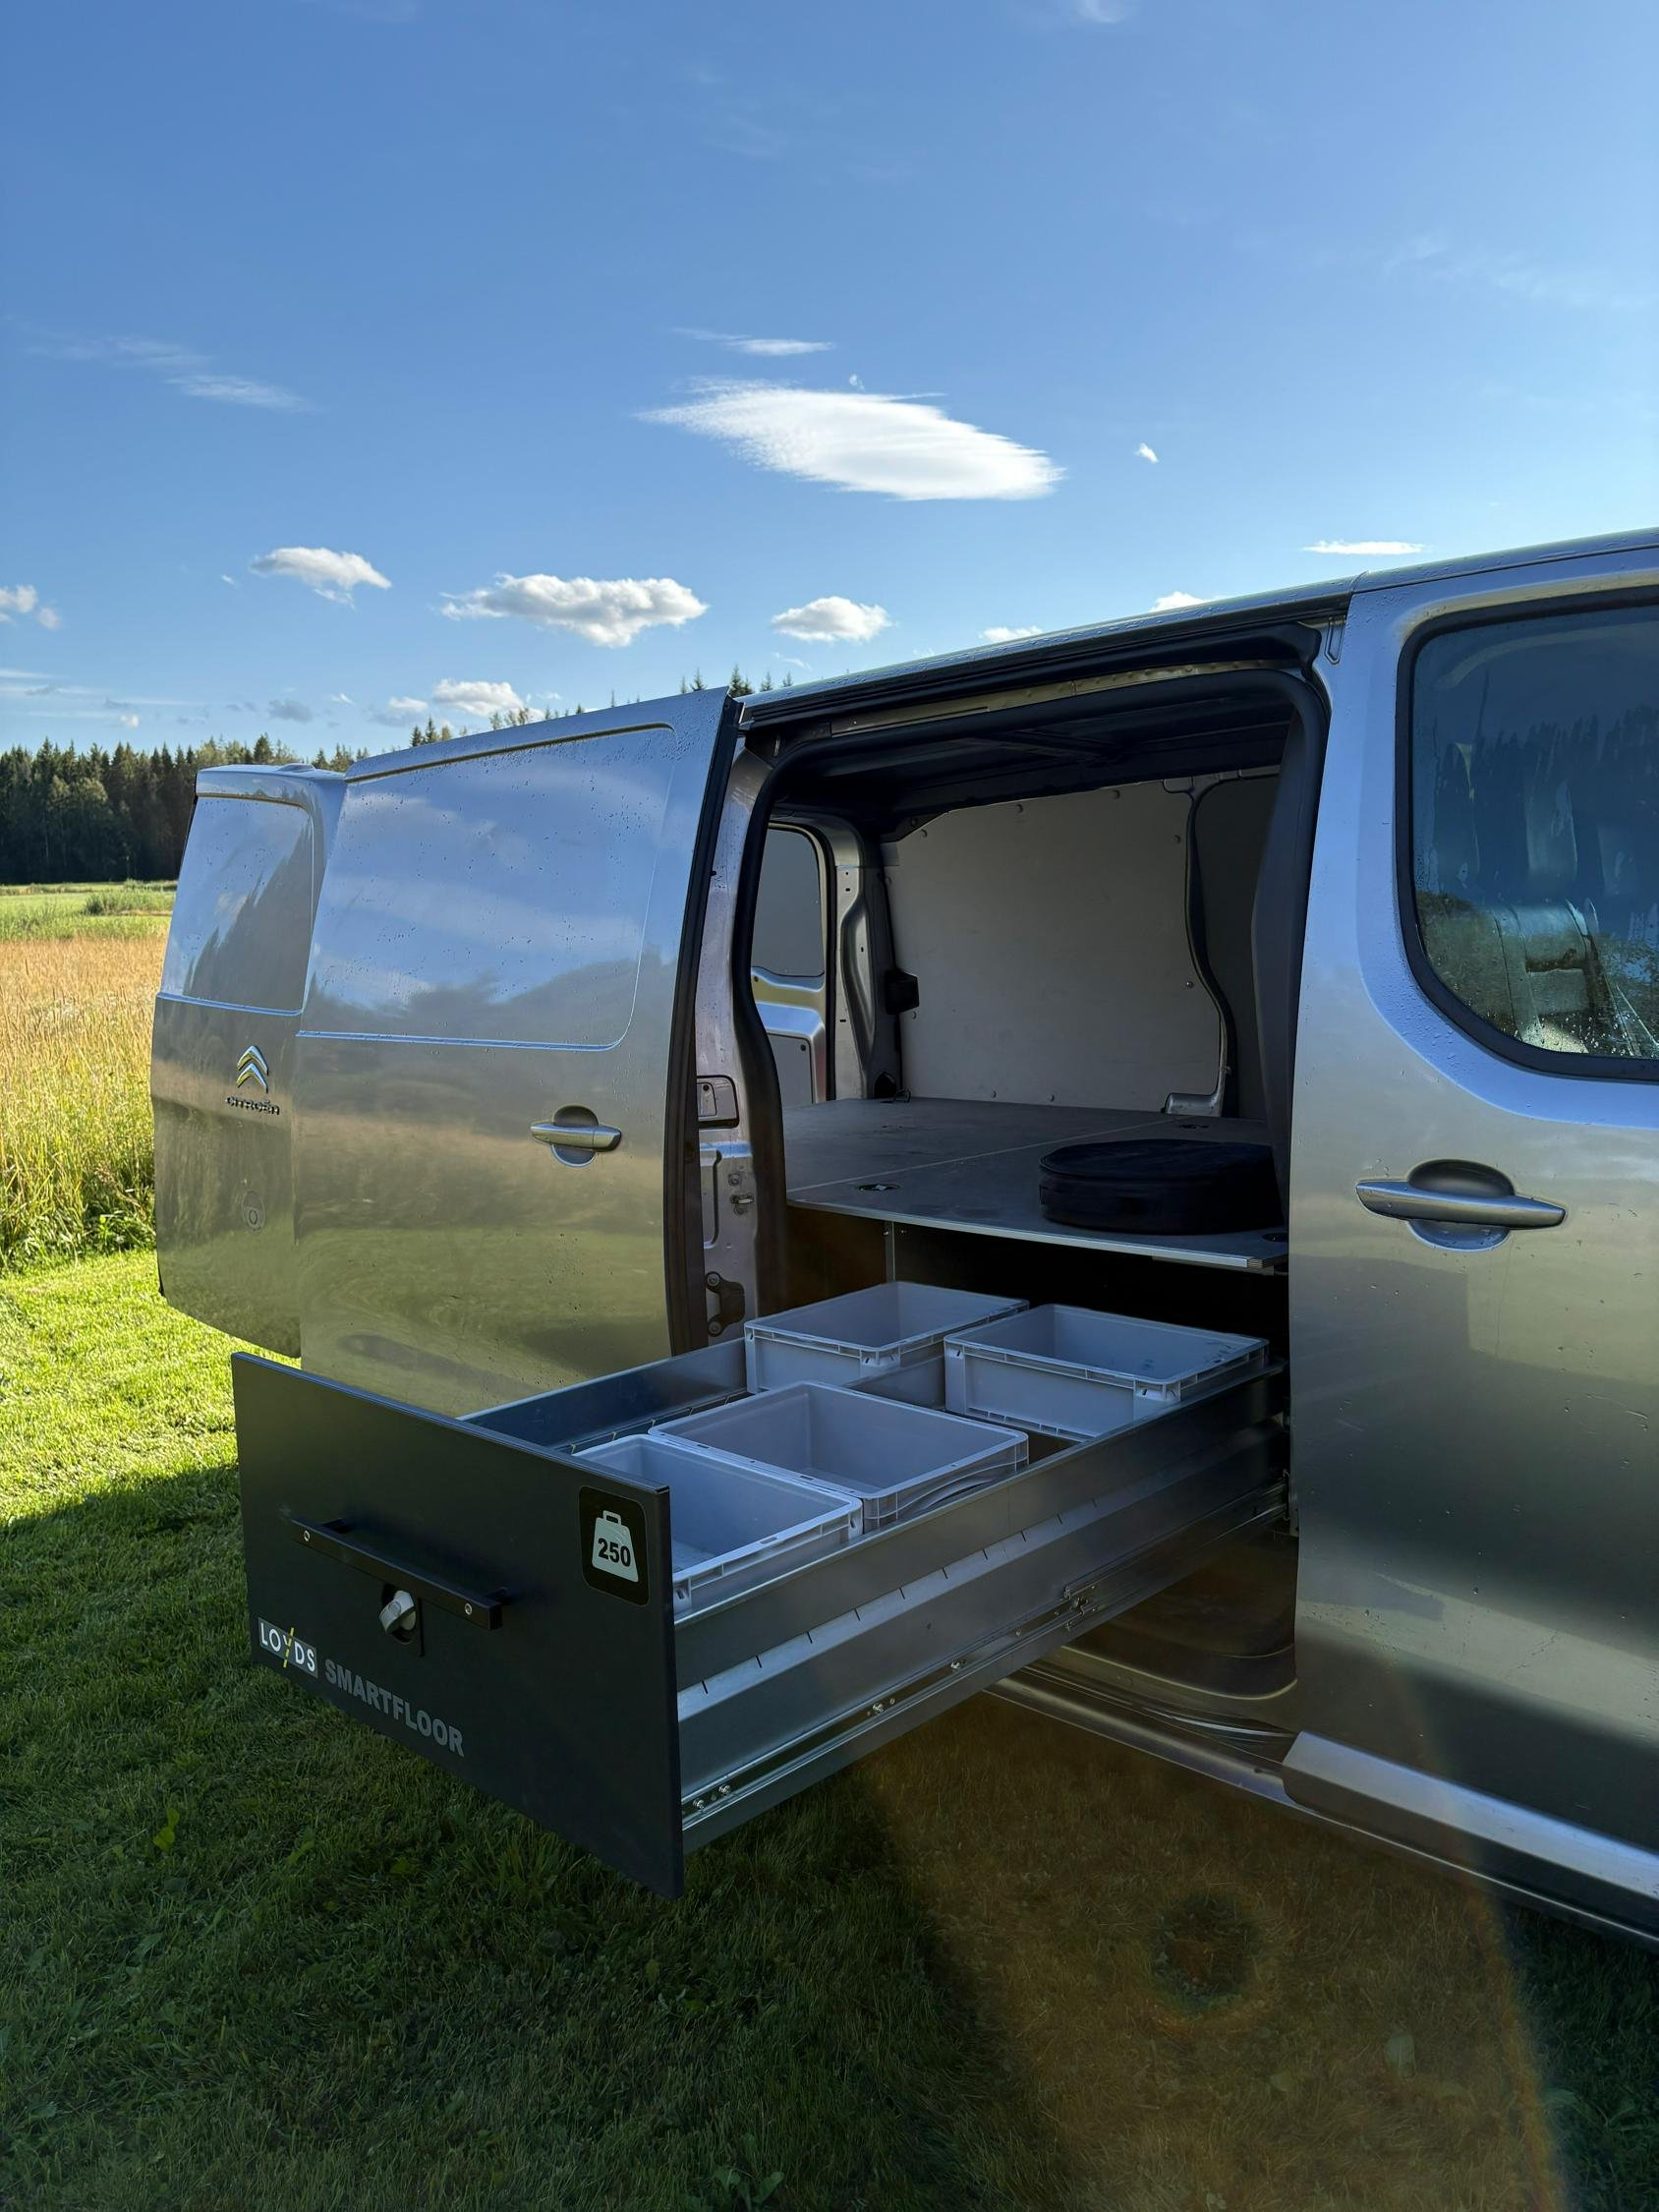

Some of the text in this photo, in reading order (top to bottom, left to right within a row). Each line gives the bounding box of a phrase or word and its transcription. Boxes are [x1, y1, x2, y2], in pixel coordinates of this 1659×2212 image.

[598, 1537, 631, 1567] 250
[259, 1622, 465, 1758] LOYDS SMARTFLOOR
